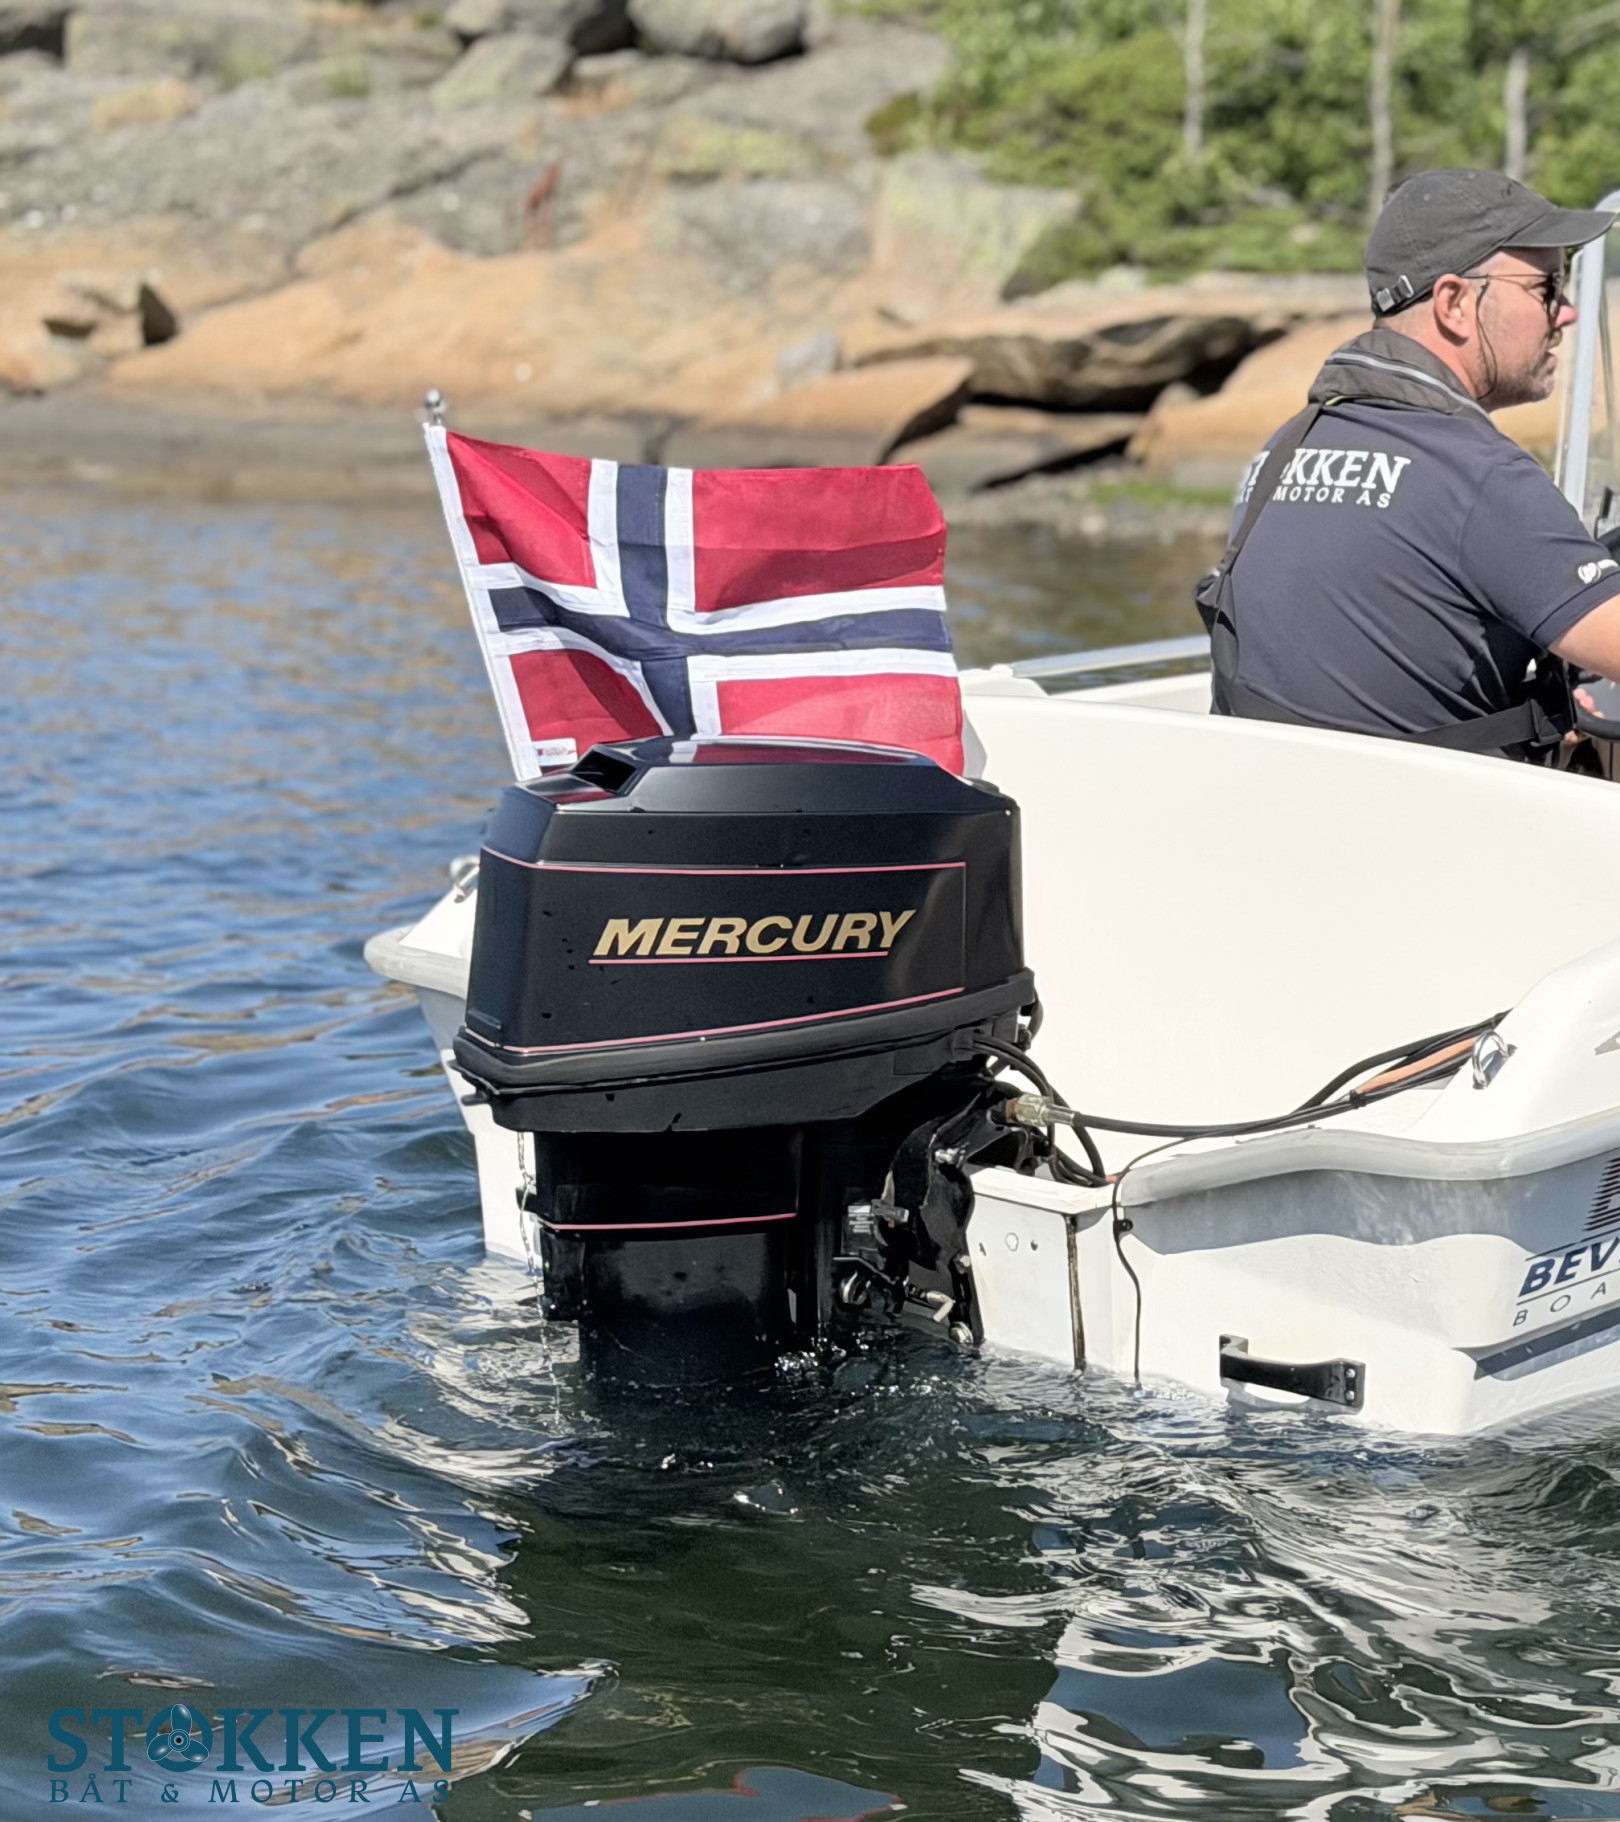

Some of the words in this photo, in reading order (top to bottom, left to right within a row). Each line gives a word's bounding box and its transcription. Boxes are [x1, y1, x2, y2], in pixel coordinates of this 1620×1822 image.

[1272, 485, 1346, 504] MOTOR
[1355, 489, 1392, 509] AS
[592, 909, 917, 957] MERCURY
